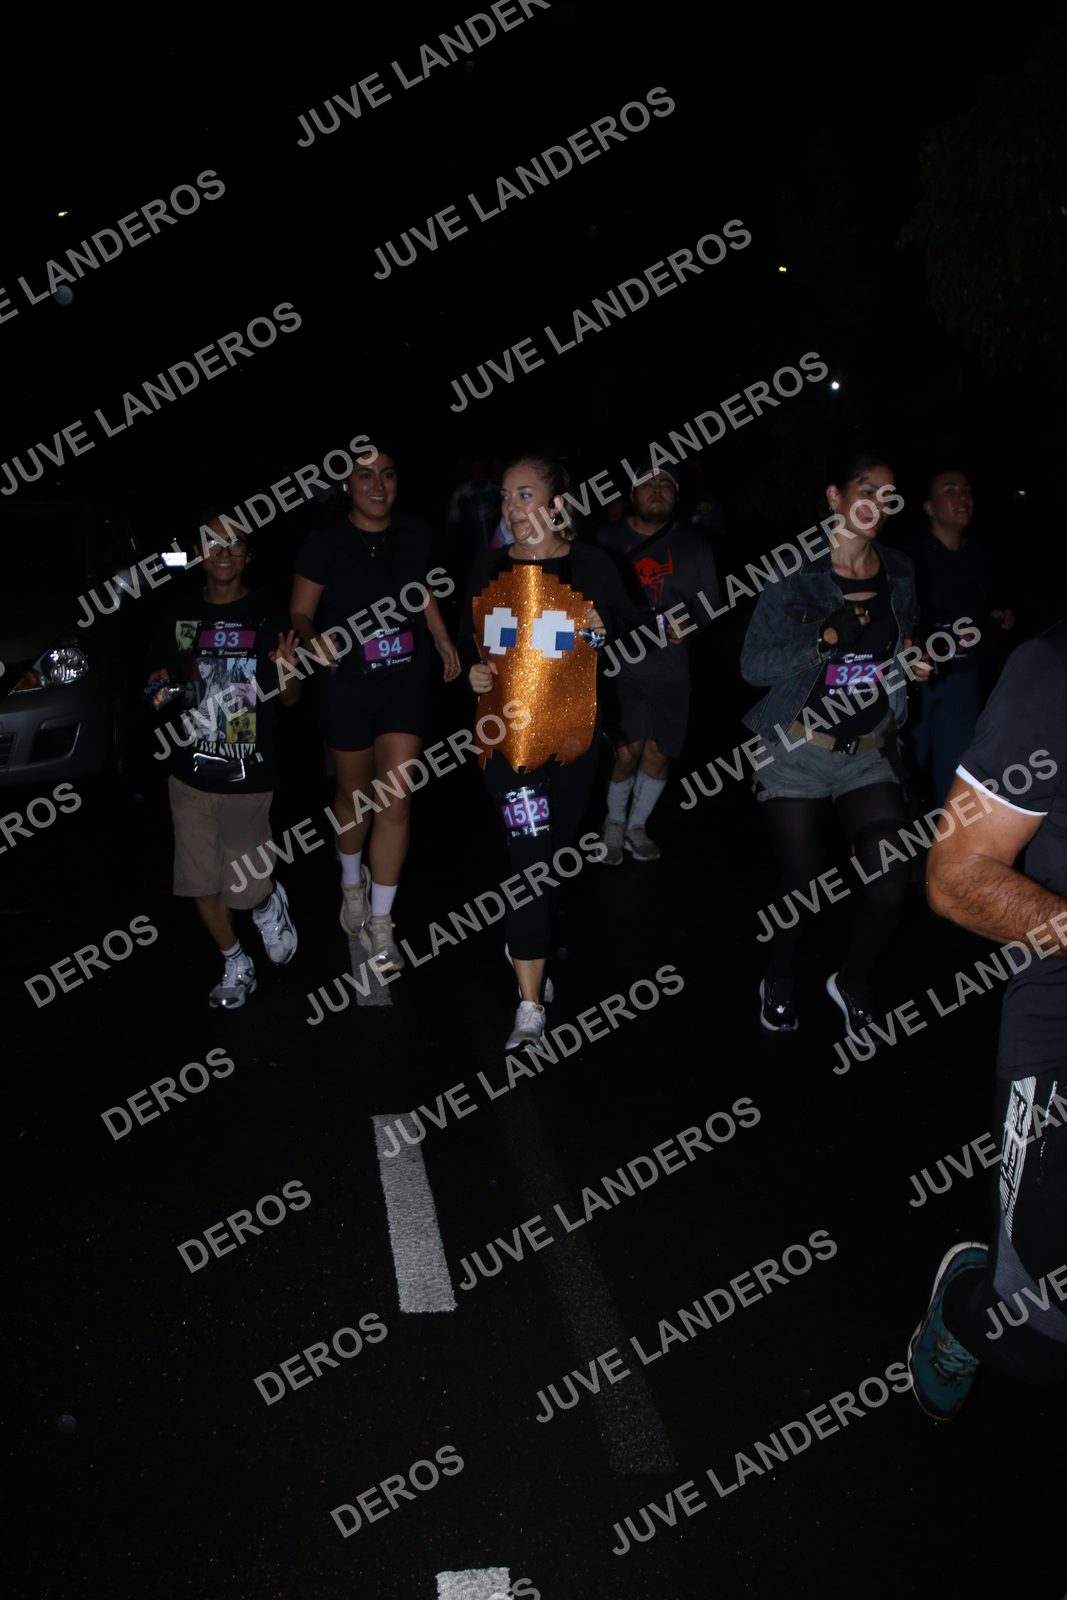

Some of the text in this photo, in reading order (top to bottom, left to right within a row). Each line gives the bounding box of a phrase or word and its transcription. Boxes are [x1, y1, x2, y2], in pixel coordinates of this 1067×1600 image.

[214, 631, 240, 648] 93
[378, 636, 402, 657] 94
[835, 664, 878, 687] 322
[504, 798, 550, 826] 1523
